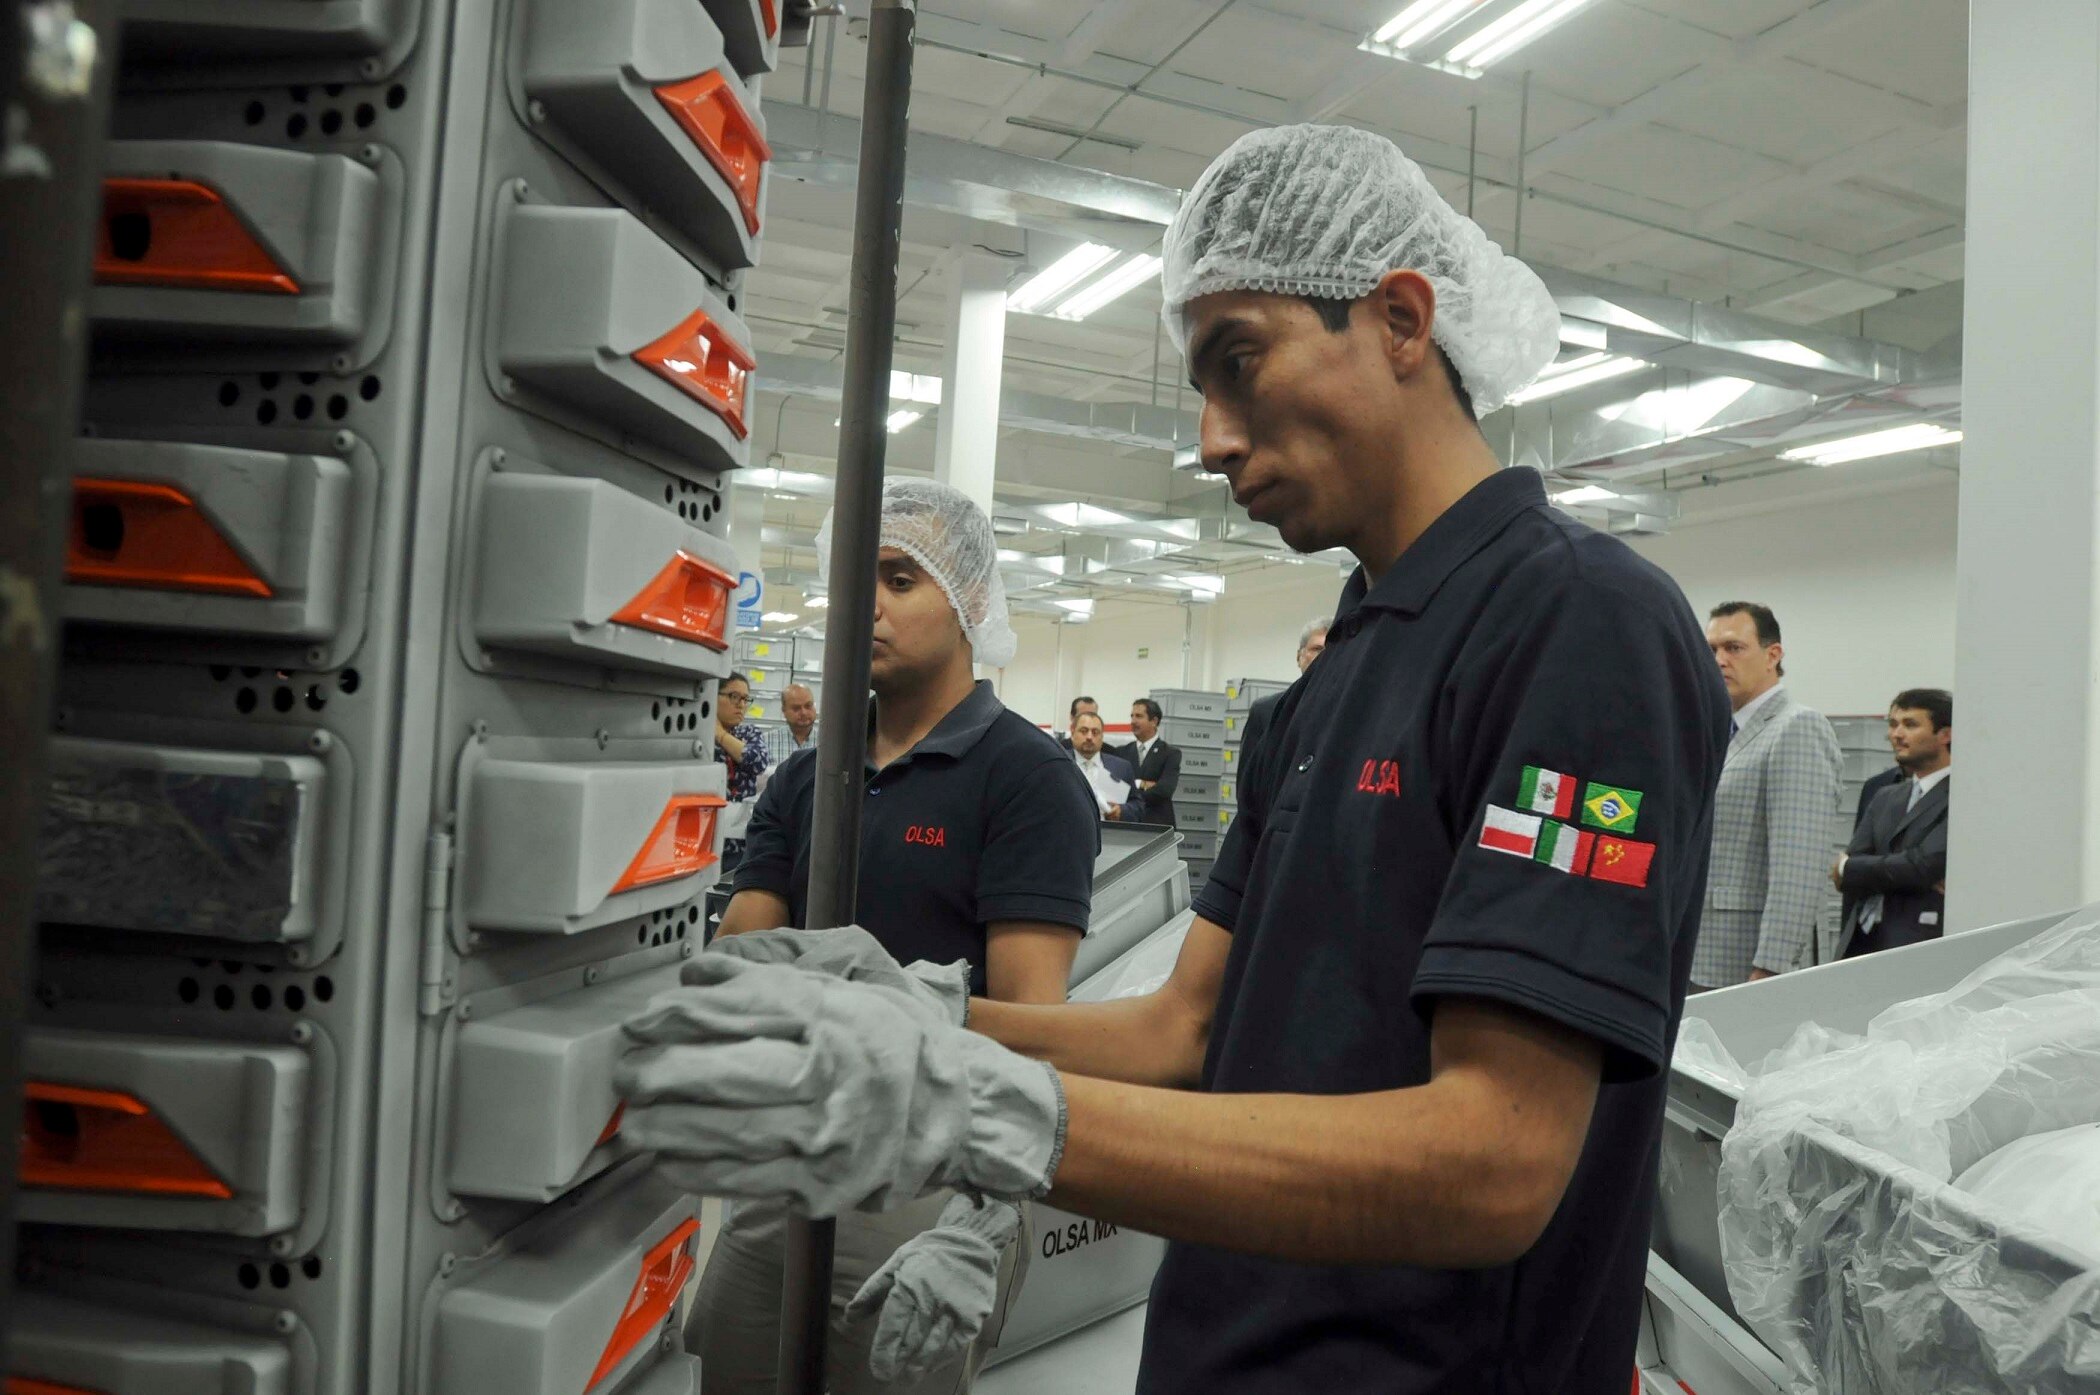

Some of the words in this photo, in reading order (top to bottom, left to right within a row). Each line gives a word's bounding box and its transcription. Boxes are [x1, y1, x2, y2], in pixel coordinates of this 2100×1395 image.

[1356, 758, 1400, 797] OLSA
[905, 825, 945, 847] OLSA
[1042, 1219, 1089, 1258] OLSA
